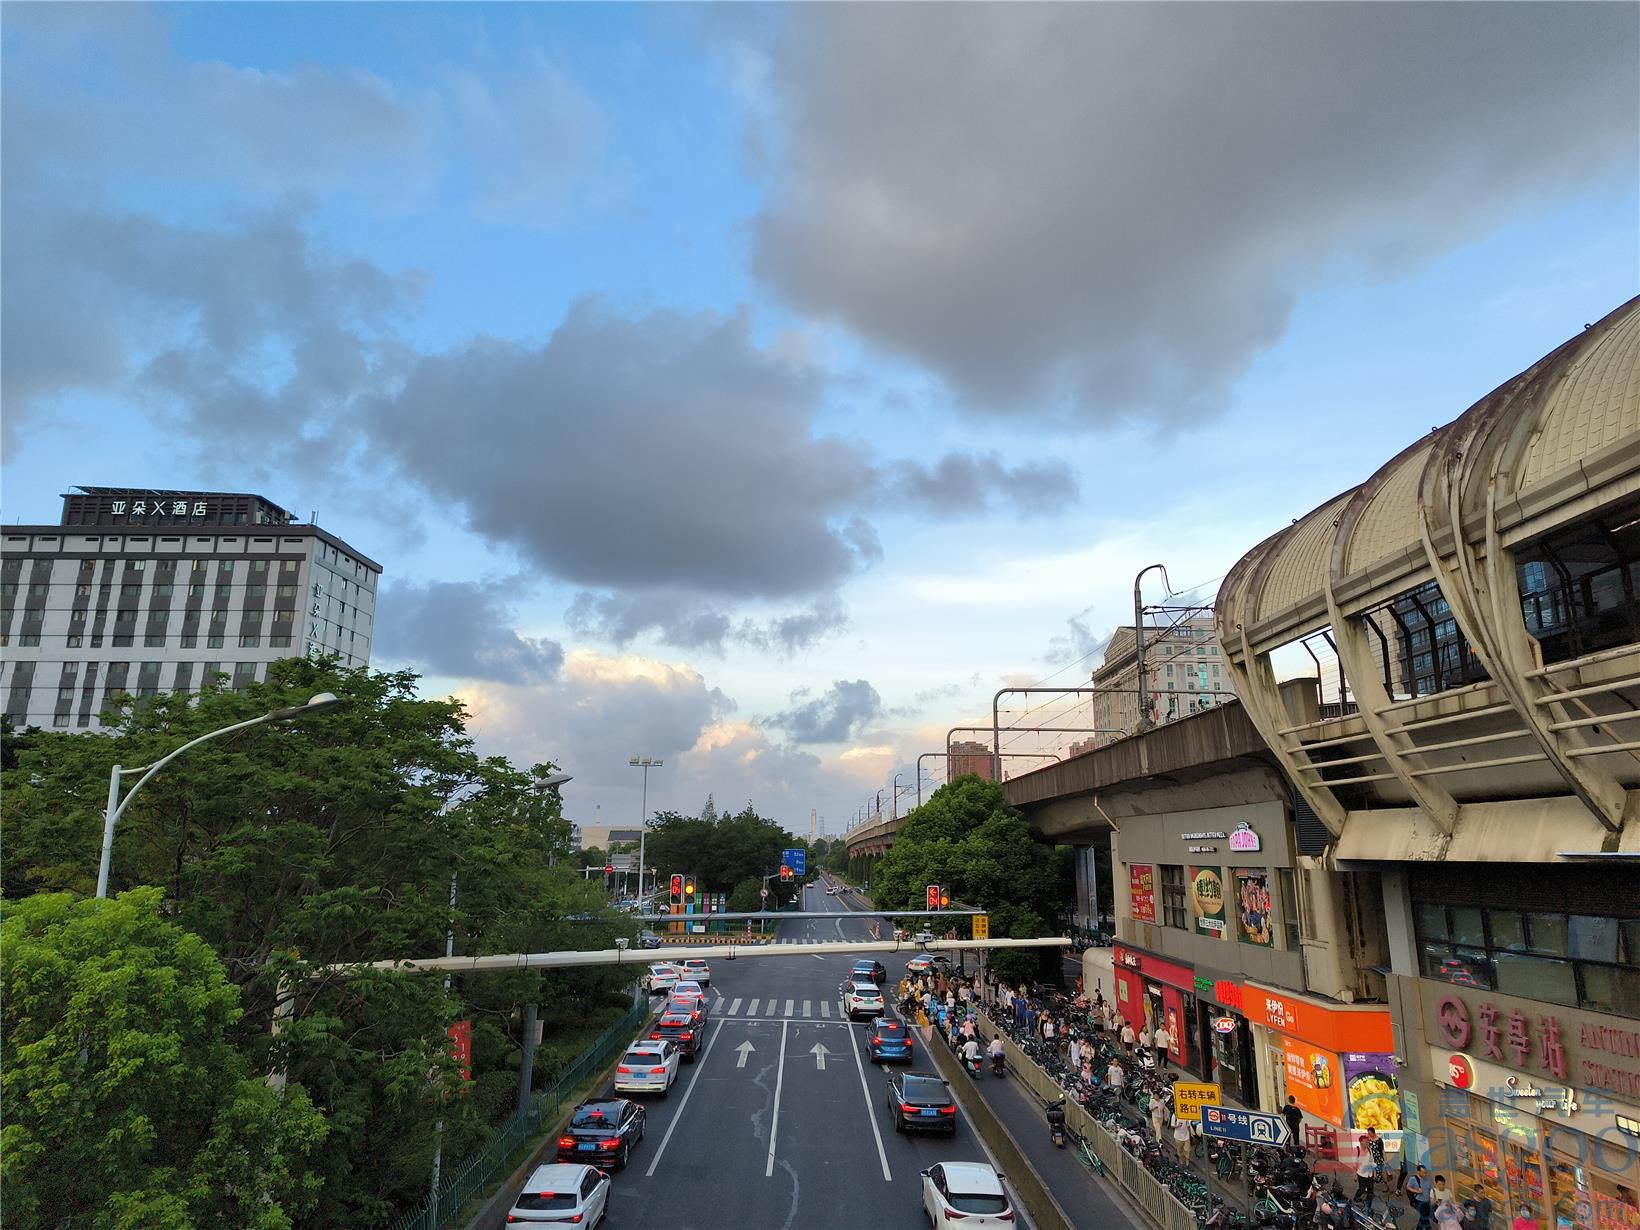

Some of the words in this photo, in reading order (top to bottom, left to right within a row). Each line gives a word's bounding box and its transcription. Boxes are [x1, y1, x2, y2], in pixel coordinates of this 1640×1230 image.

[111, 501, 208, 516] 亚朵X酒店
[1266, 998, 1284, 1016] 来伊份
[1266, 1012, 1286, 1028] LYFEN
[1480, 1003, 1567, 1080] 安亭站
[1504, 1076, 1541, 1097] Sweeten
[1179, 1089, 1216, 1101] 右转车辆
[1179, 1103, 1201, 1114] 路口
[1210, 1125, 1222, 1133] LINE
